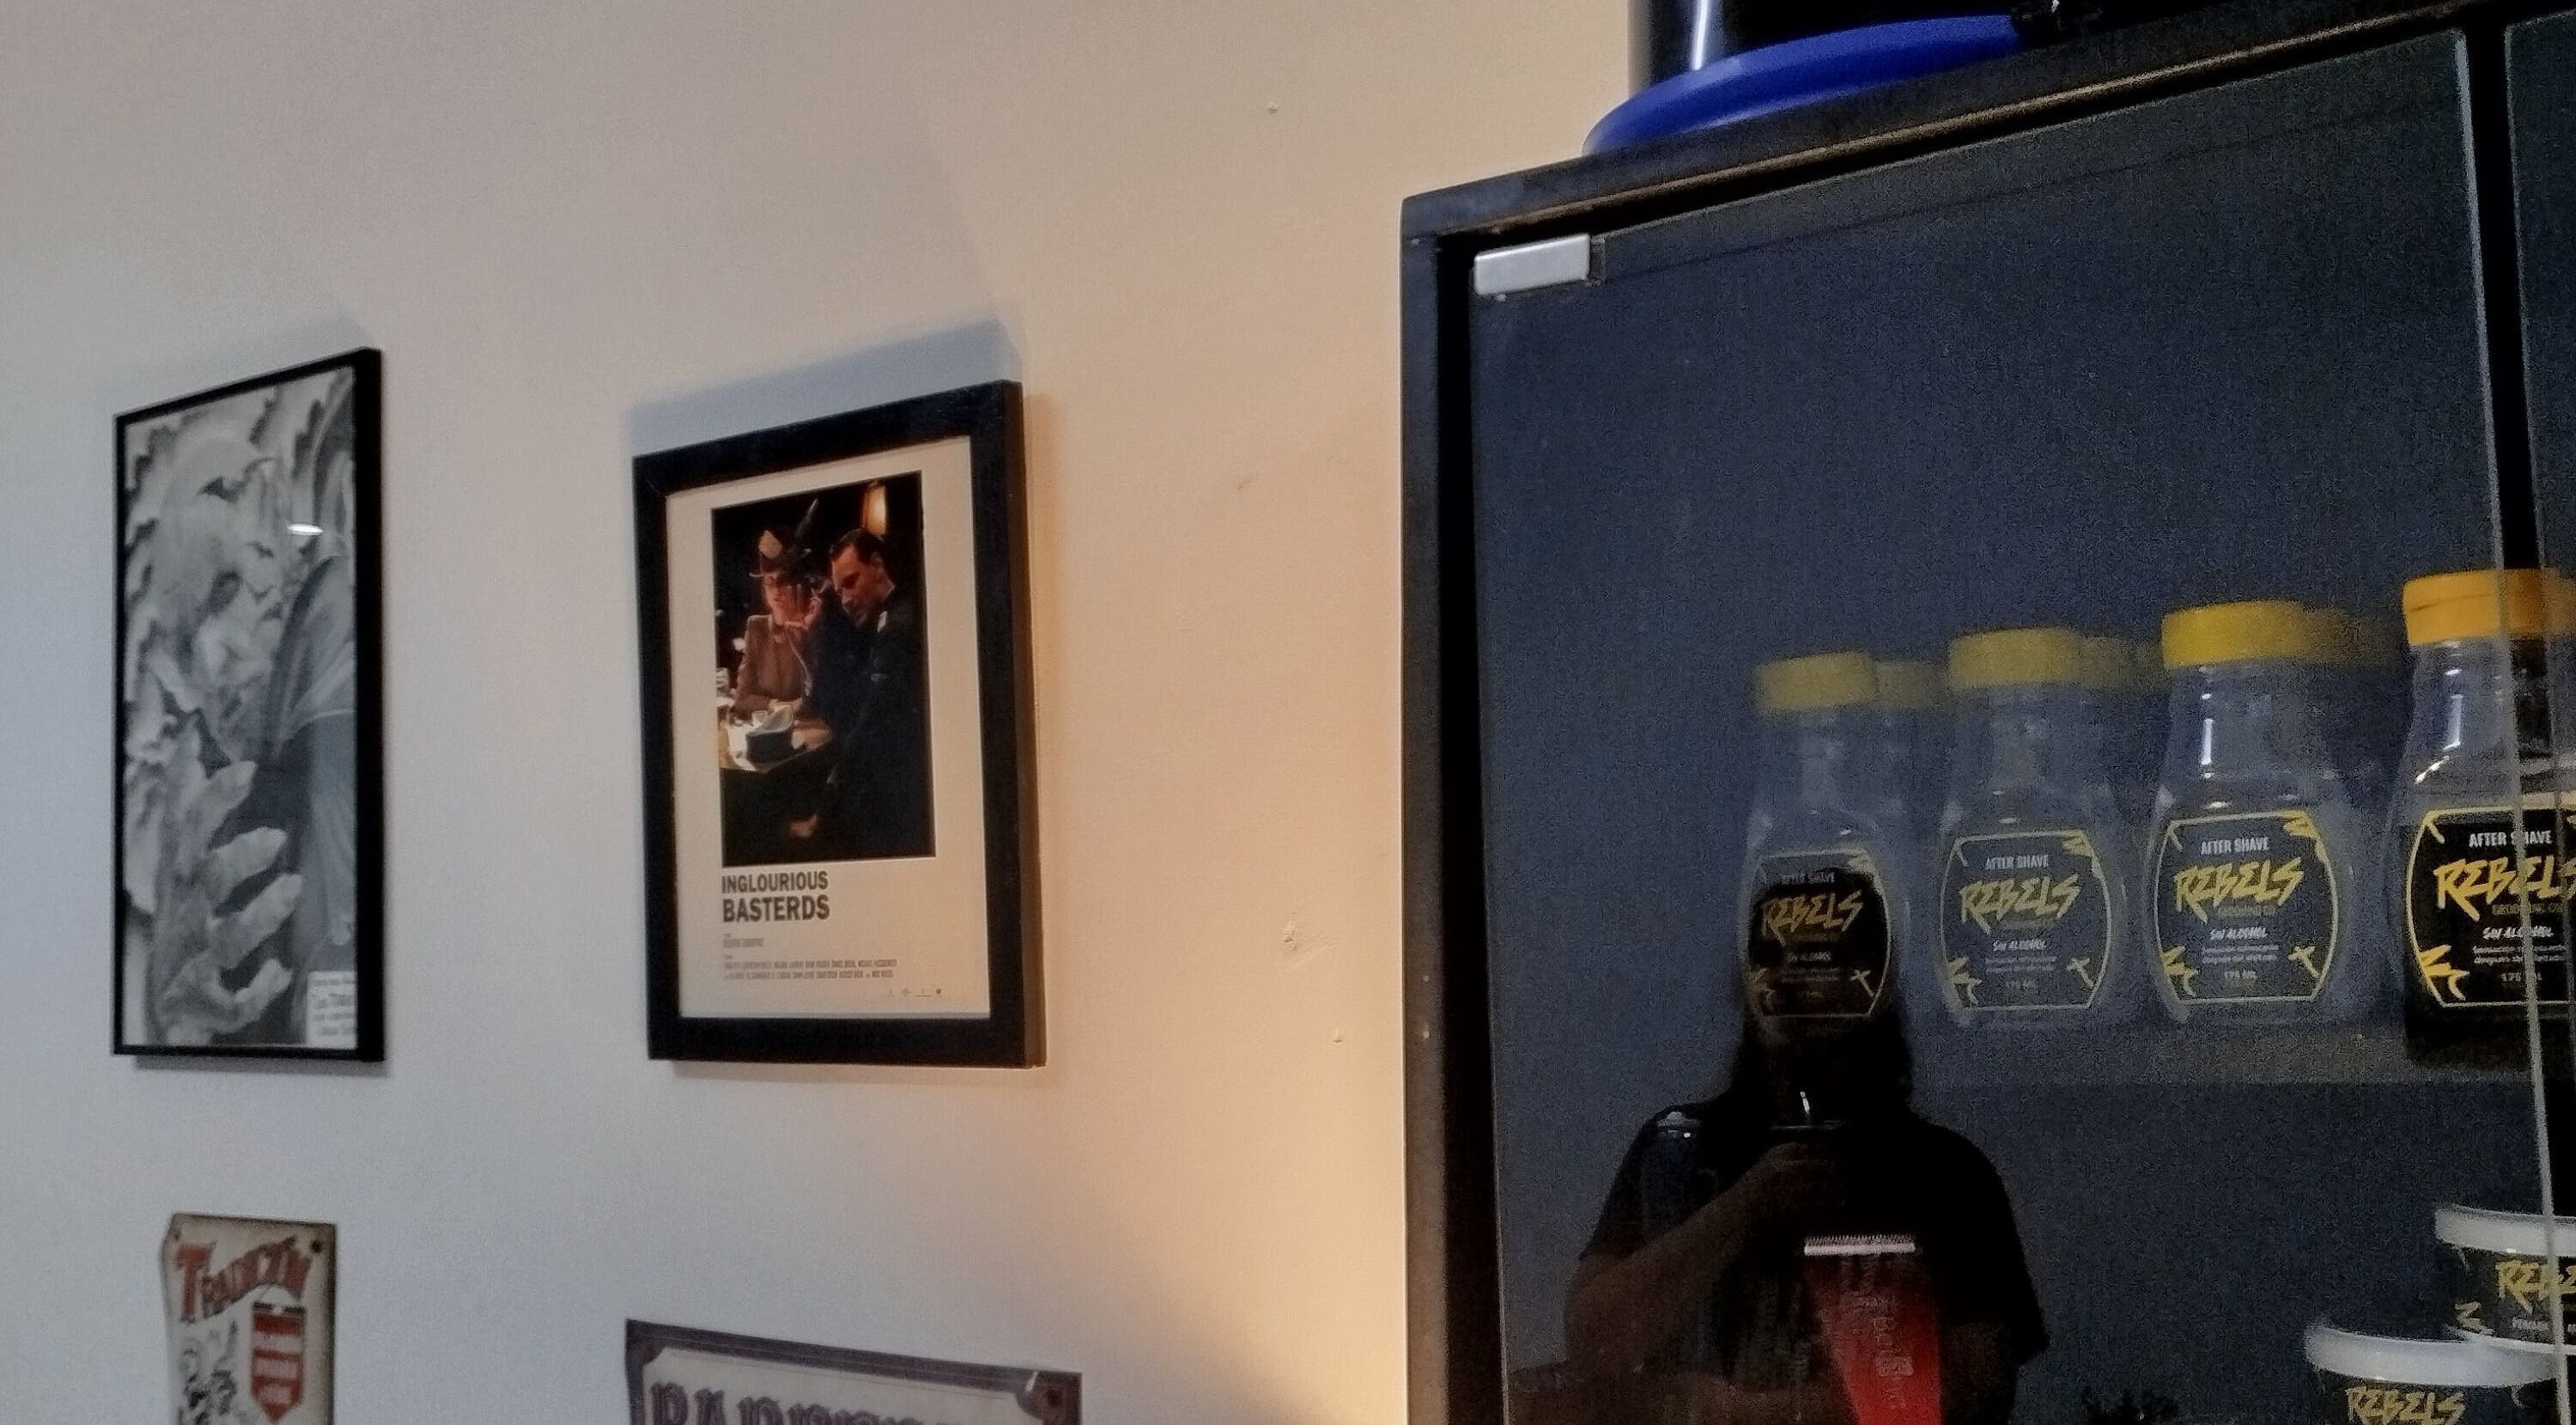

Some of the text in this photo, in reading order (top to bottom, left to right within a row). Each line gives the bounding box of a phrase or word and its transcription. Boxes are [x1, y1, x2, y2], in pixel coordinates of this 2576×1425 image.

[2201, 837, 2269, 855] AFTER SHAVE
[2469, 832, 2507, 848] AFTER
[1985, 854, 2049, 870] AFTER SHAVE
[721, 870, 829, 894] INGLOURIOUS
[2173, 857, 2305, 923] REBELS
[722, 894, 831, 923] BASTERDS
[1959, 874, 2082, 935] REBELS
[1763, 890, 1863, 947] REBELS
[2504, 925, 2555, 938] ALCHOL
[2345, 1386, 2466, 1425] REBELS
